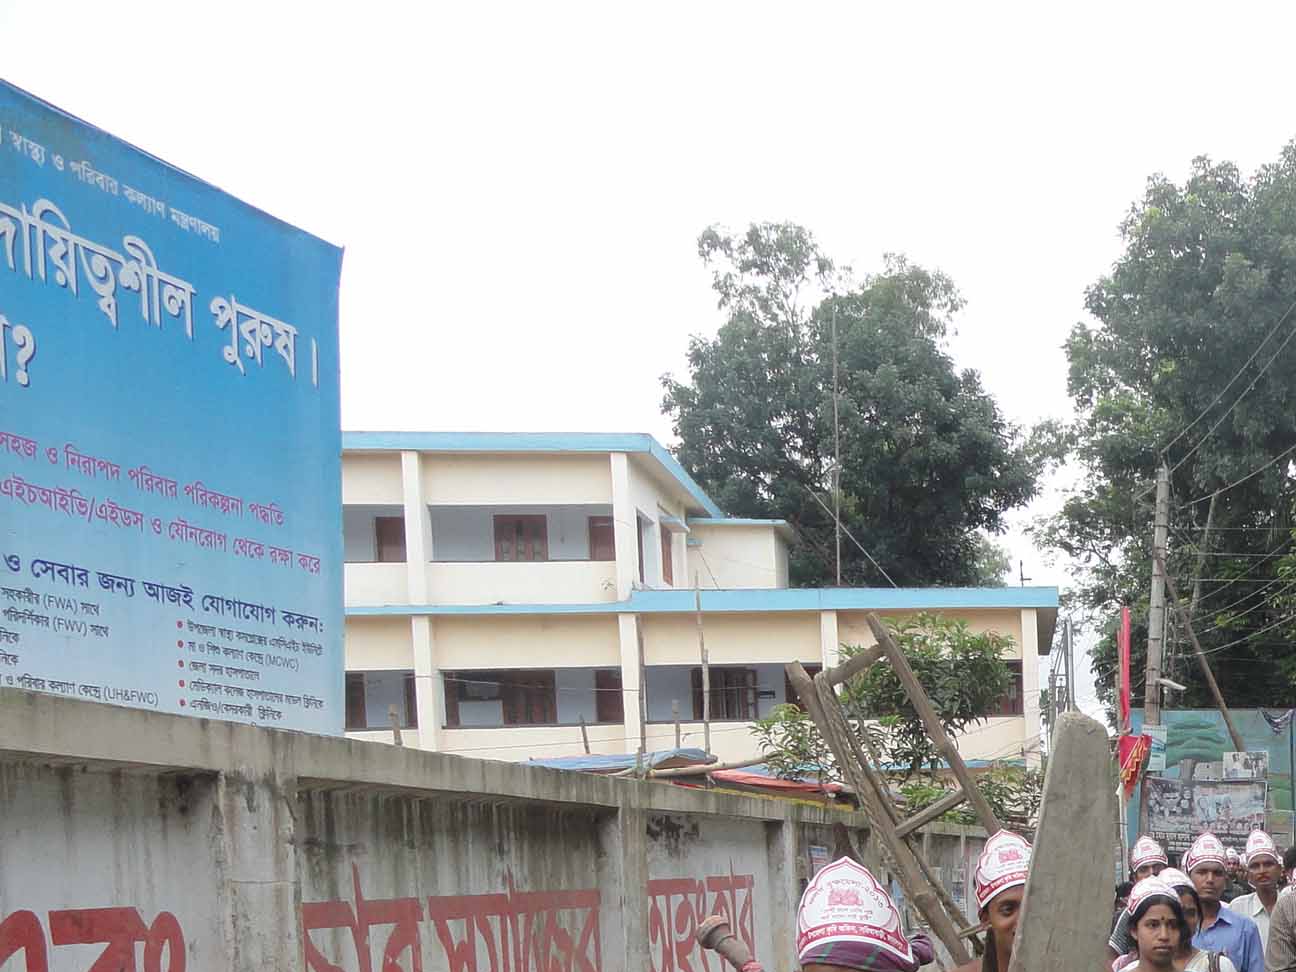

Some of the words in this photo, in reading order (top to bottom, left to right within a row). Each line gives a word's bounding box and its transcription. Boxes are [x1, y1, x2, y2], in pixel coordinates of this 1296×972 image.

[52, 154, 65, 171] ও
[210, 295, 299, 381] পুরুষ
[46, 447, 58, 464] ও
[64, 443, 121, 481] নিরাপদ
[127, 465, 178, 498] পরিবার
[248, 502, 285, 528] পদ্ধতি
[151, 517, 162, 535] ও
[168, 518, 228, 553] যৌনরোগ
[233, 537, 265, 560] থেকে
[298, 552, 321, 577] করে
[3, 554, 21, 574] ও
[31, 558, 90, 589] সেবার
[96, 571, 136, 599] জন্য
[143, 580, 195, 611] আজই
[201, 593, 277, 626] যোগাযোগ
[43, 594, 78, 615] (FWA)
[53, 616, 88, 638] (FWV)
